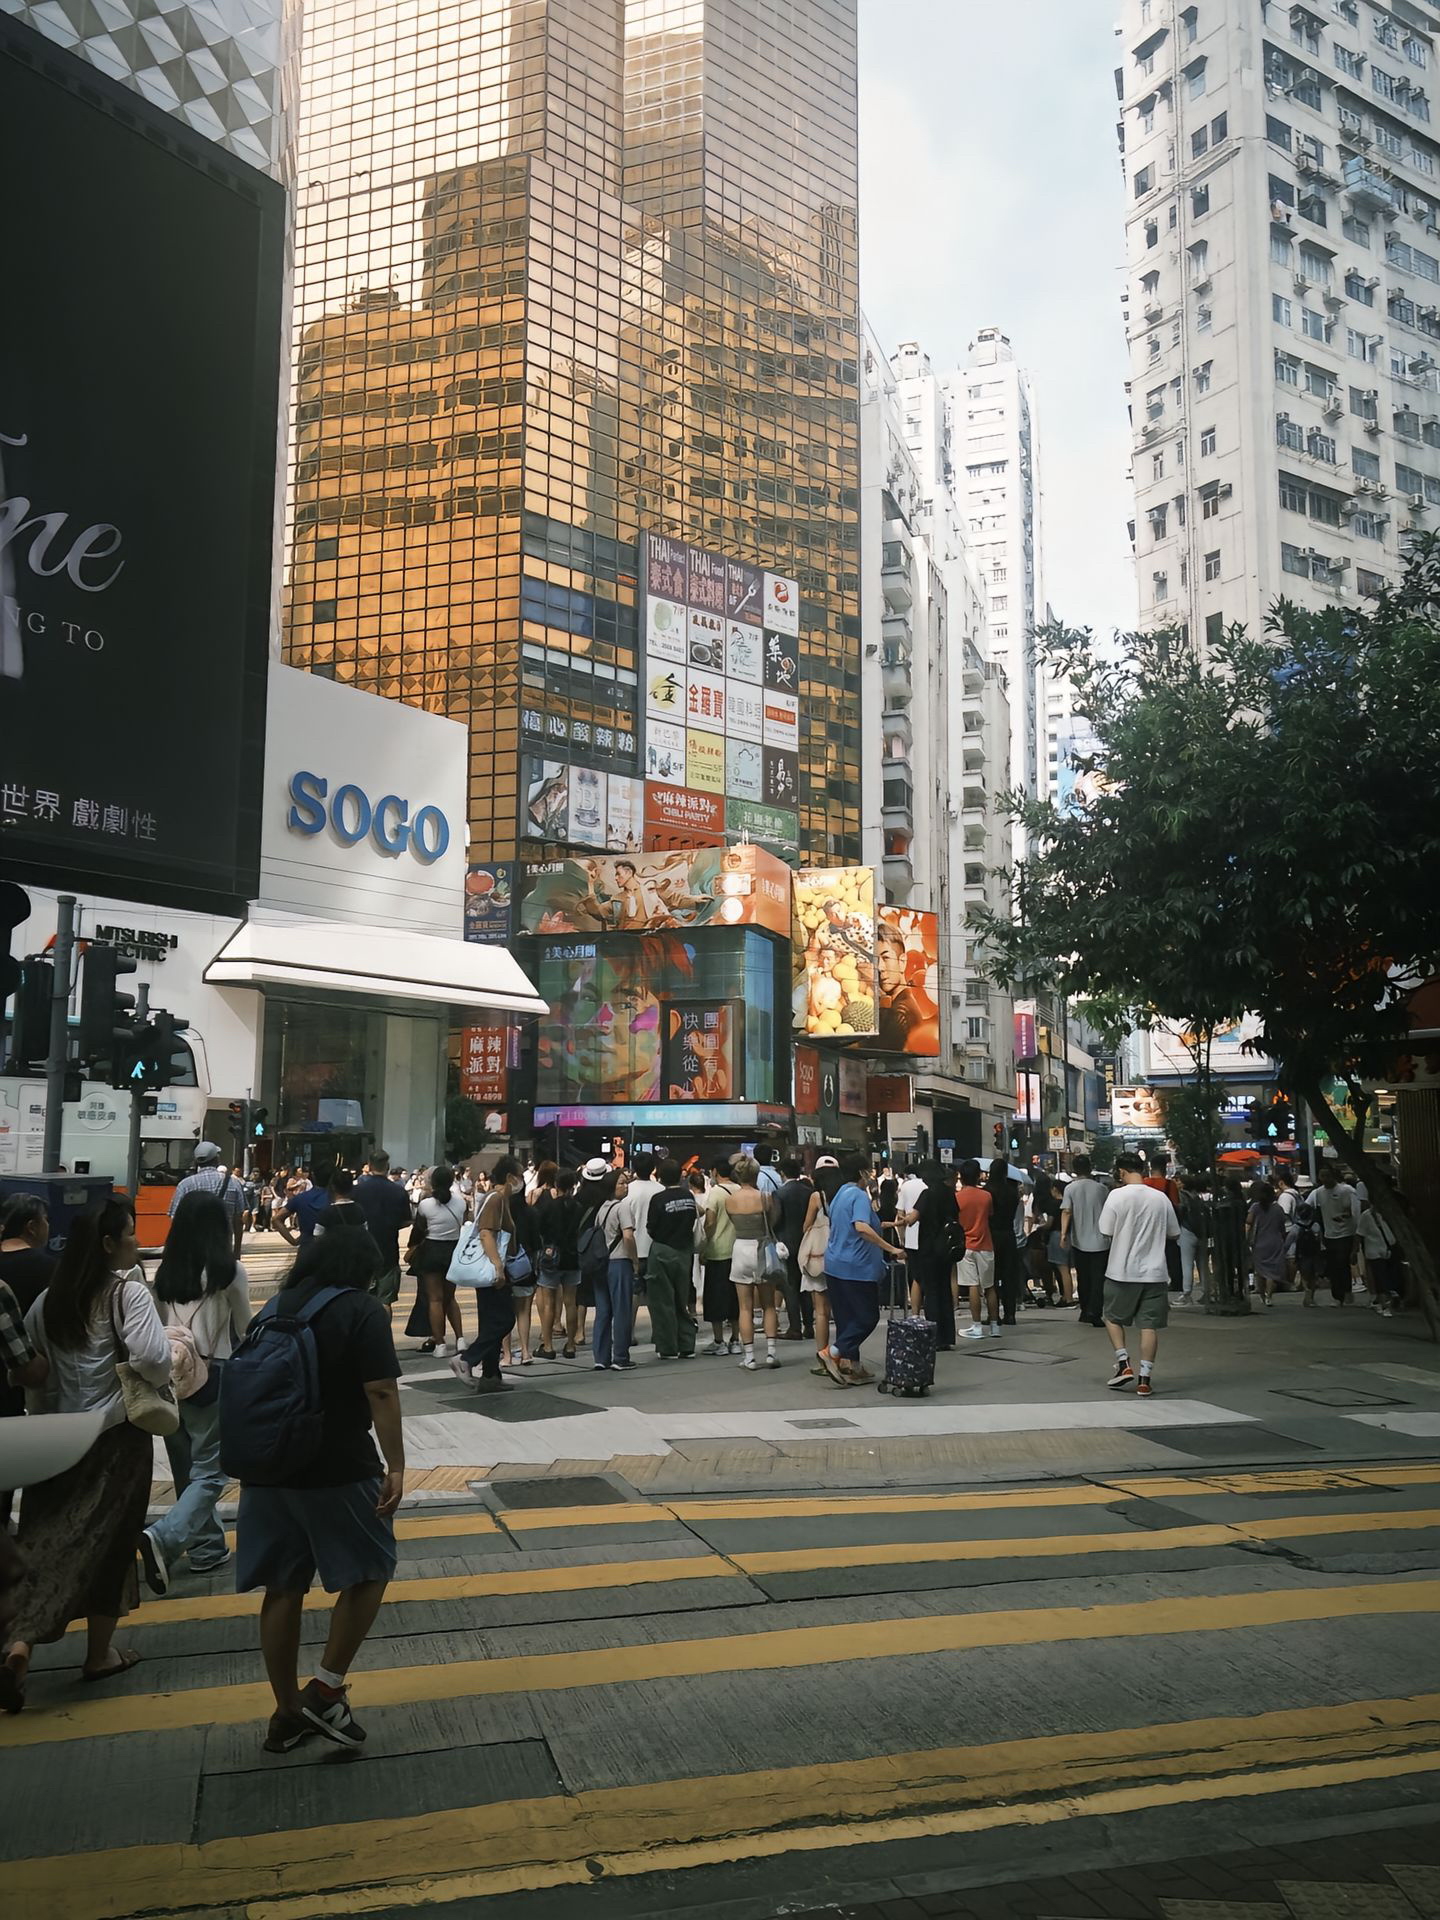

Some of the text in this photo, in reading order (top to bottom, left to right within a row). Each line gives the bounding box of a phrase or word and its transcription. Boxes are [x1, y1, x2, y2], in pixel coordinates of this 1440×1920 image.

[650, 535, 670, 563] THAI
[690, 548, 711, 578] THAI
[728, 563, 743, 582] THAI
[62, 621, 104, 651] TO
[1, 784, 157, 841] 世界 戲劇性
[288, 771, 450, 862] SOGO
[96, 924, 178, 949] MITSUBISHI
[469, 1036, 502, 1054] 麻辣
[469, 1056, 501, 1074] 派對
